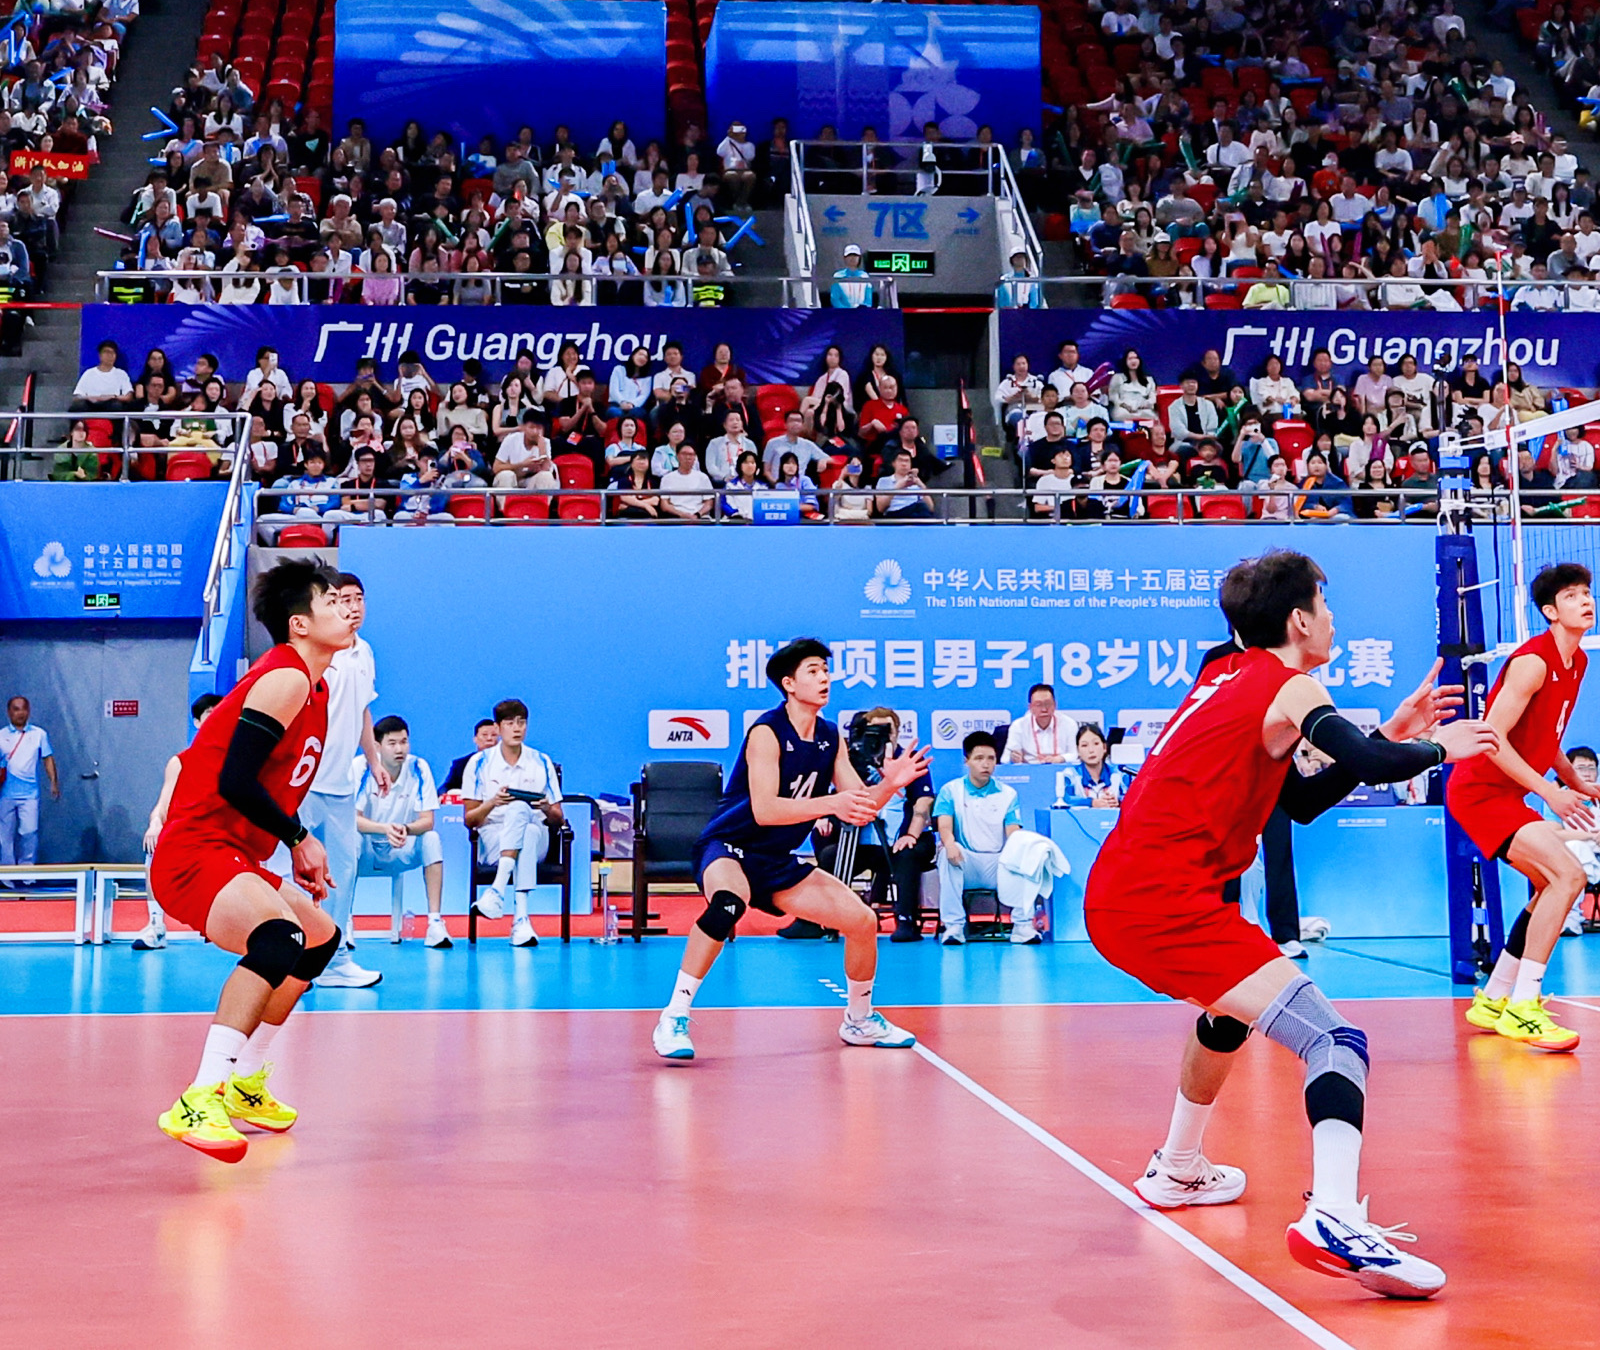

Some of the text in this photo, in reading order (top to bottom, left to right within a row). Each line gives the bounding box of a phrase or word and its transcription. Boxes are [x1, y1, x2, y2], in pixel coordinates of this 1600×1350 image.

[867, 203, 929, 239] 7区
[912, 260, 927, 269] EXIT
[314, 321, 667, 369] 广州 Guangzhou
[1222, 326, 1559, 367] 广州 Guangzhou
[84, 544, 182, 556] 中华人民共和国
[925, 596, 947, 608] The
[950, 596, 976, 608] 15th
[979, 596, 1028, 608] National
[1031, 596, 1071, 608] Games
[1074, 596, 1086, 608] of
[1088, 596, 1107, 608] the
[1109, 596, 1158, 610] People's
[1161, 596, 1211, 610] Republic
[667, 730, 693, 742] ANTA
[1555, 700, 1570, 740] 4
[289, 736, 322, 787] 6
[789, 771, 818, 800] 14
